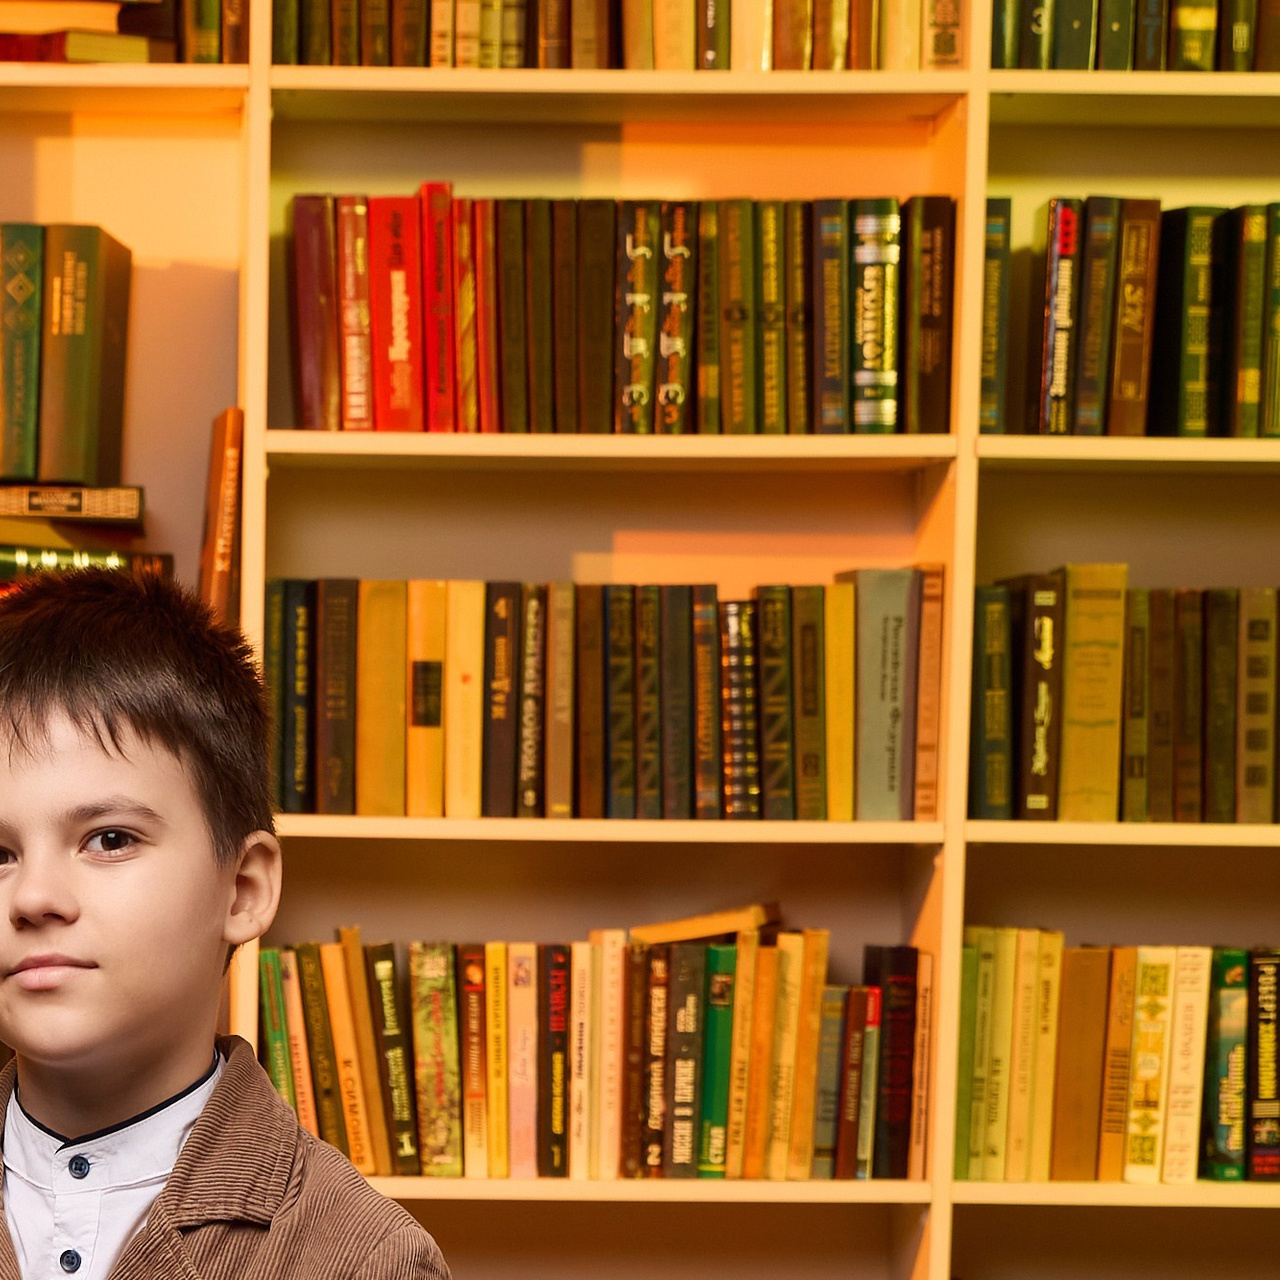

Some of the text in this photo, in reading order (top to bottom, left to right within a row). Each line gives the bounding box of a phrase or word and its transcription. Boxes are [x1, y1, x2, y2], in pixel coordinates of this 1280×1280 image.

[1259, 964, 1277, 1100] РОБЕРТ ХАЙНЛАЙН
[672, 1058, 696, 1164] МИССИЯ В ПАРИЖЕ
